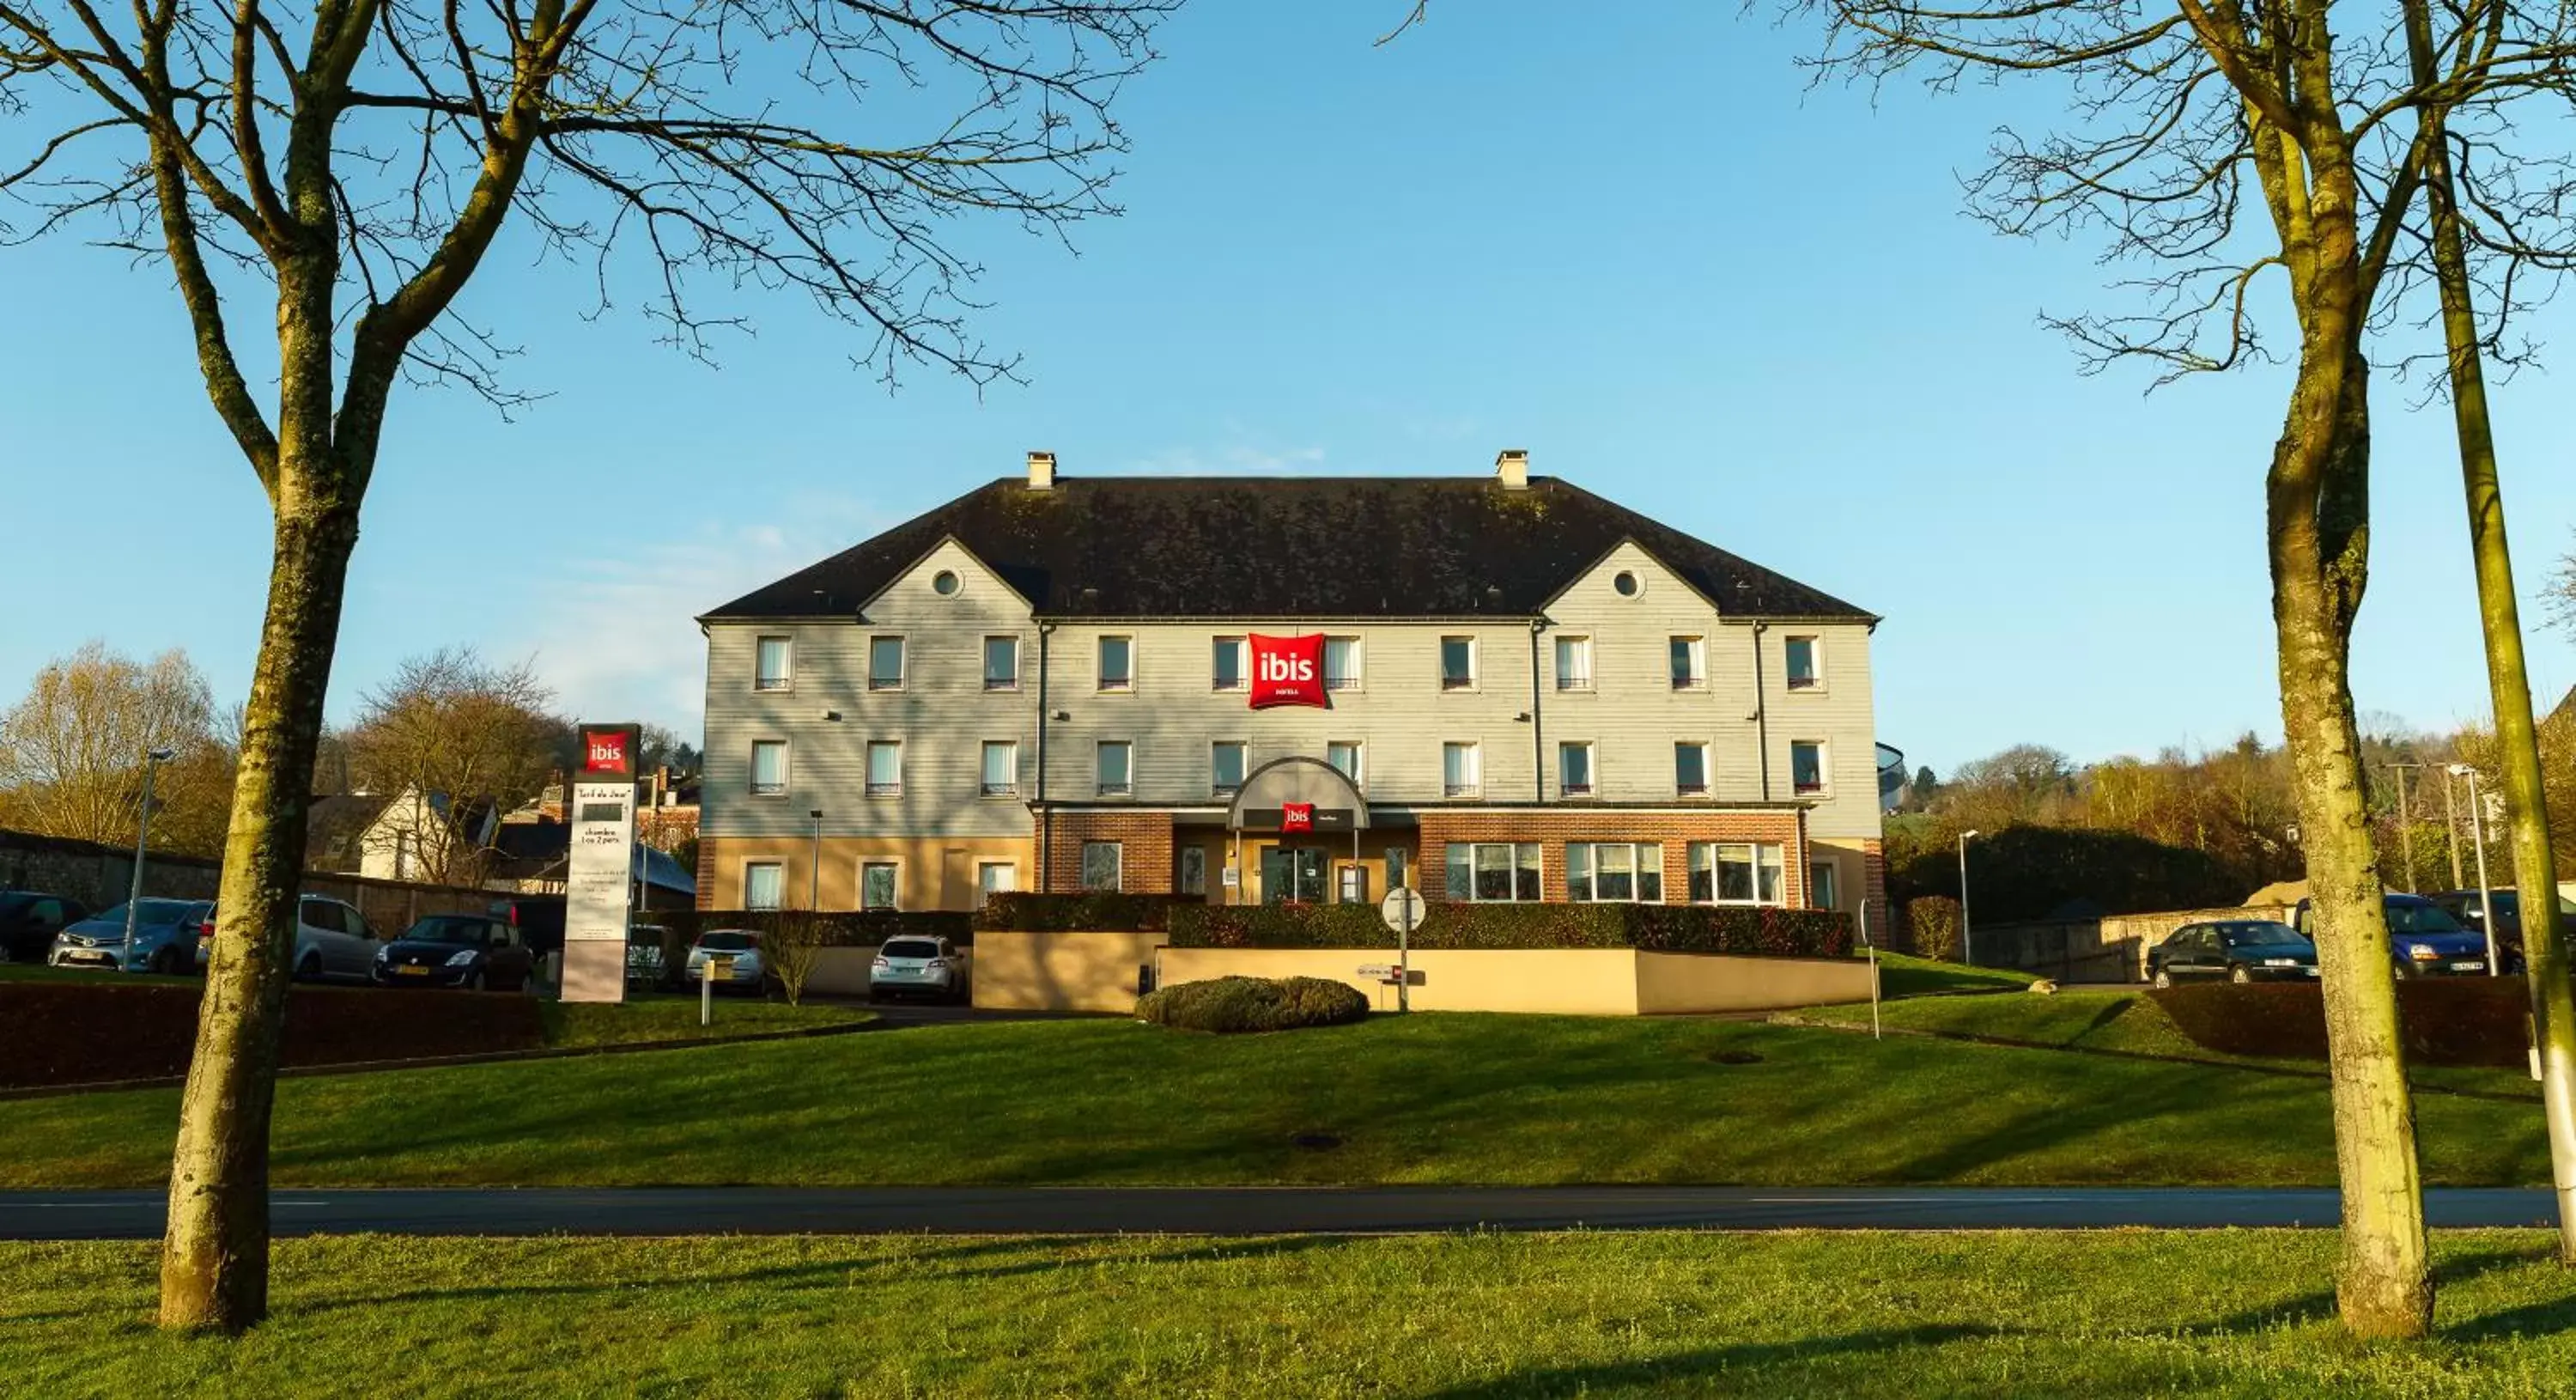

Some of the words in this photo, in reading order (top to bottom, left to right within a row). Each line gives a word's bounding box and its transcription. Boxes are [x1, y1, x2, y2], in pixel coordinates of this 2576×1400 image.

[1261, 652, 1313, 681] ibis
[592, 744, 622, 761] ibis
[1287, 810, 1309, 822] ibis
